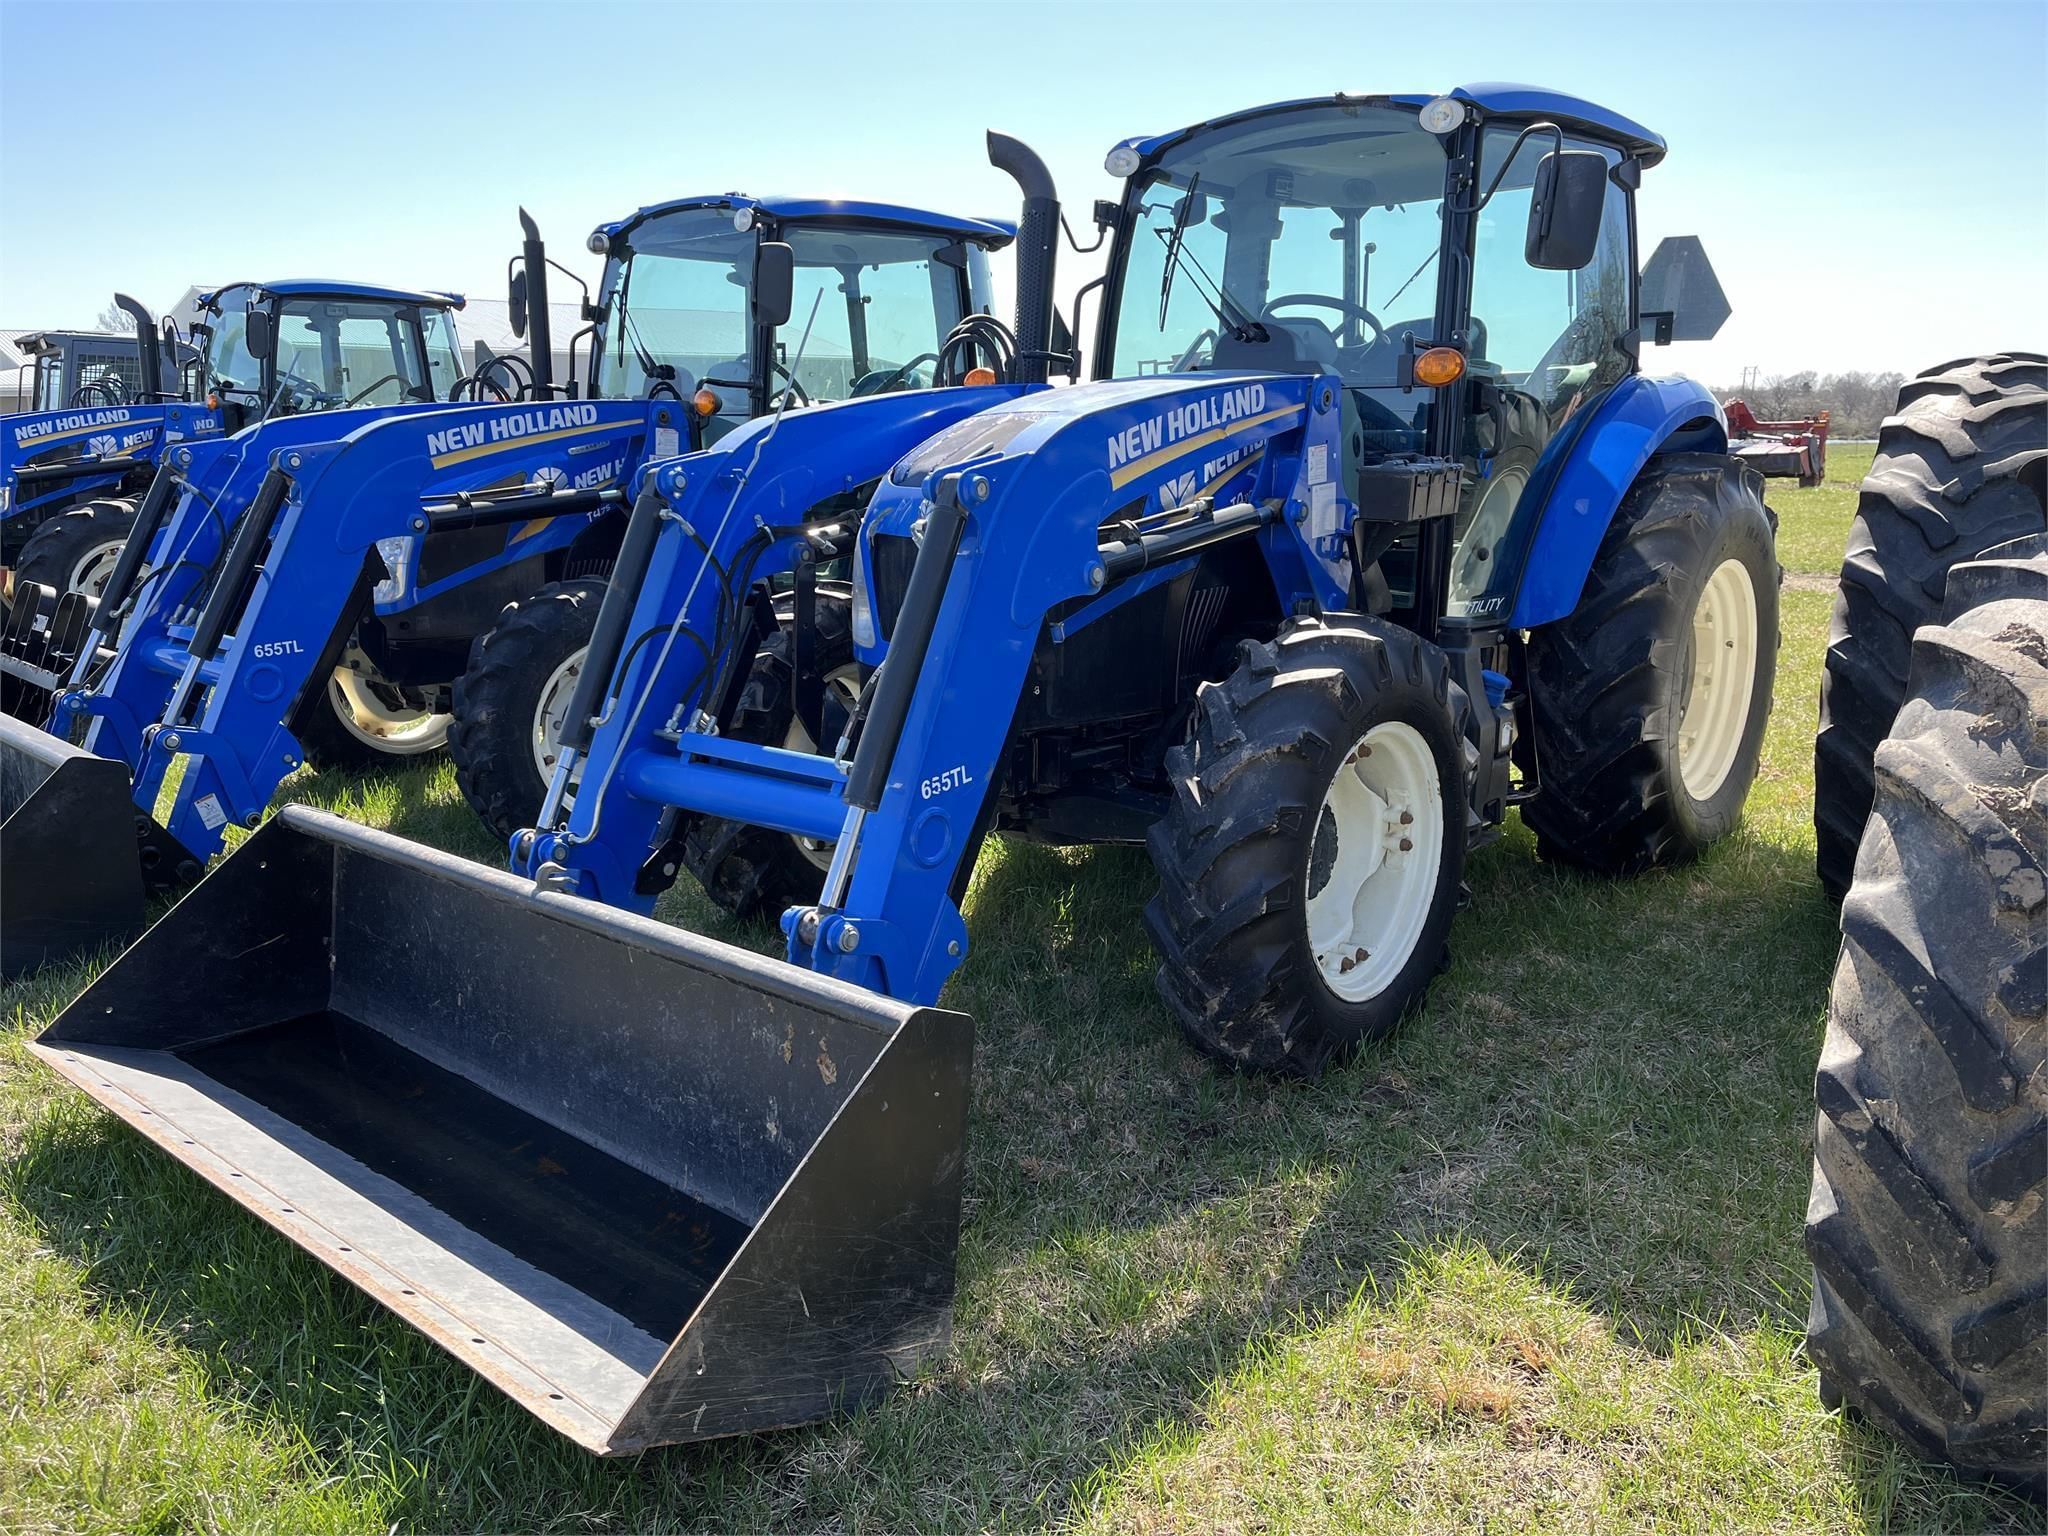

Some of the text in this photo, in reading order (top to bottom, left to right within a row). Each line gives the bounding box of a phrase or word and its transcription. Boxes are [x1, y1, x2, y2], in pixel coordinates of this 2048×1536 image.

[14, 409, 130, 441] NEW HOLLAND
[123, 428, 155, 447] NEW
[427, 404, 598, 456] NEW HOLLAND
[1107, 383, 1266, 469] NEW HOLLAND
[574, 462, 612, 489] NEW
[254, 640, 304, 658] 655TL
[921, 764, 973, 800] 655TL
